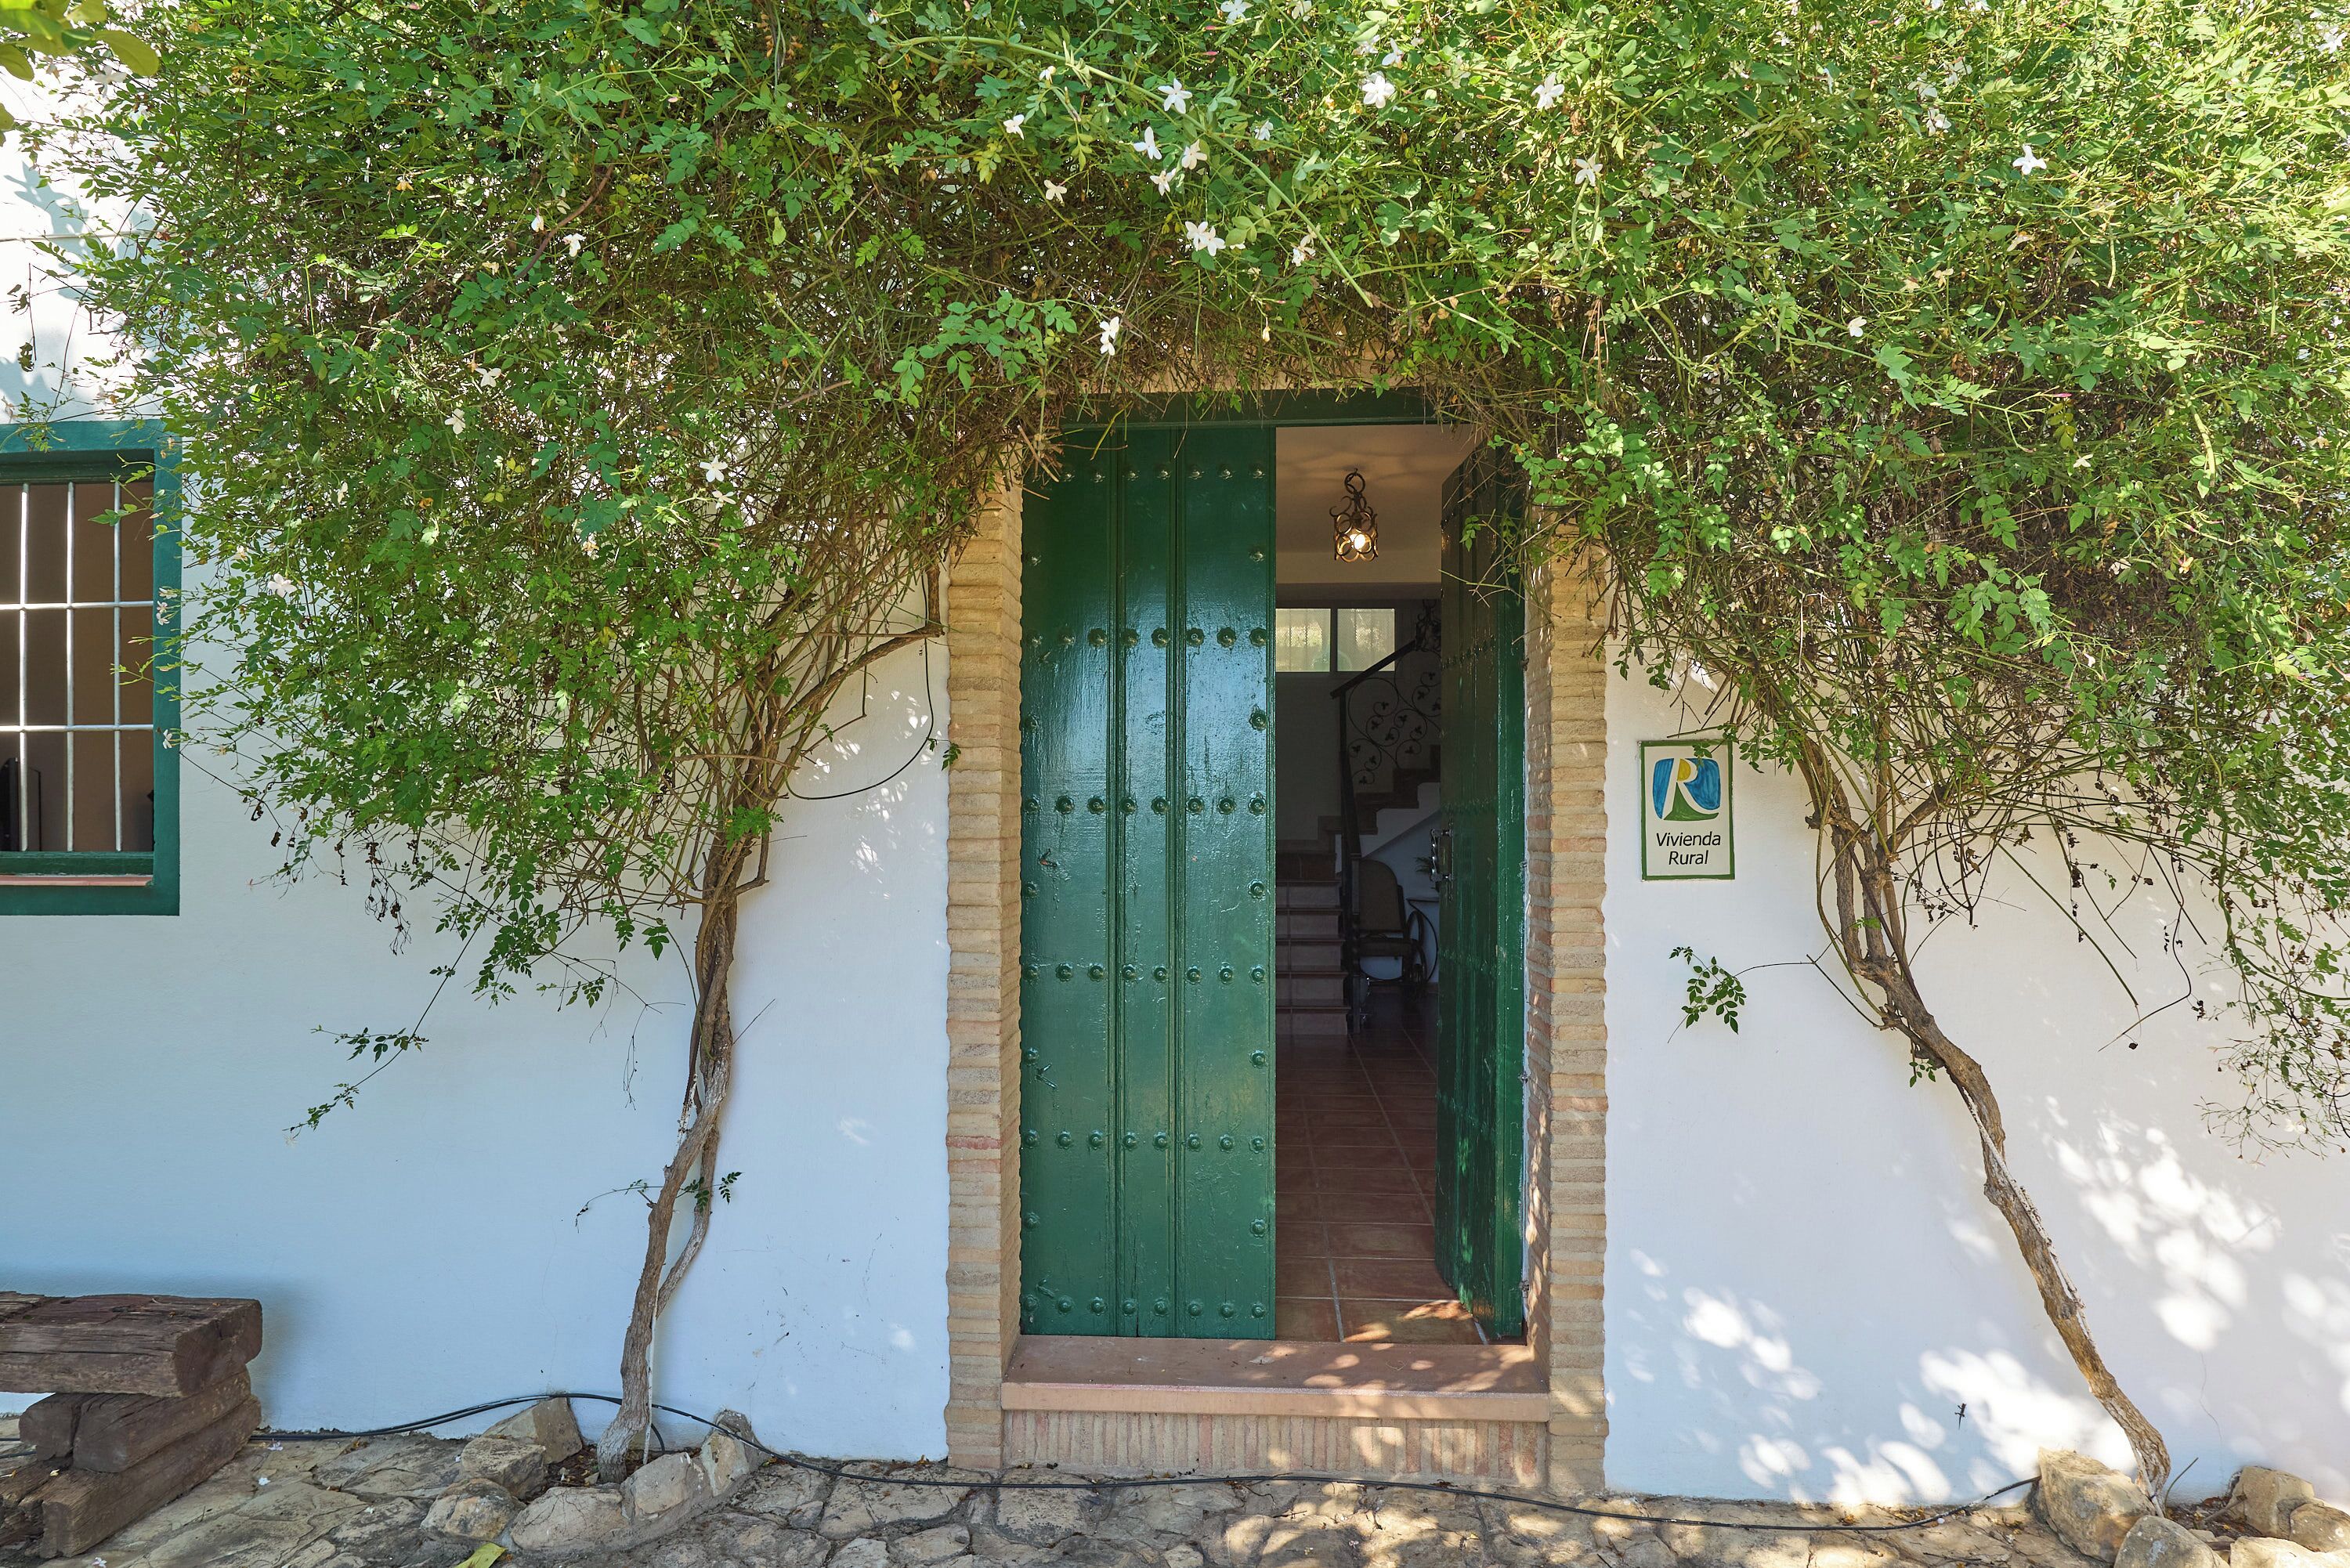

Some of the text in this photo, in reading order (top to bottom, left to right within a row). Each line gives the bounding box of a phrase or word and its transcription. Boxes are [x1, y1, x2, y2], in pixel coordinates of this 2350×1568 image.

[1656, 757, 1721, 820] R
[1656, 831, 1721, 847] Vivienda
[1668, 850, 1708, 865] Rural
